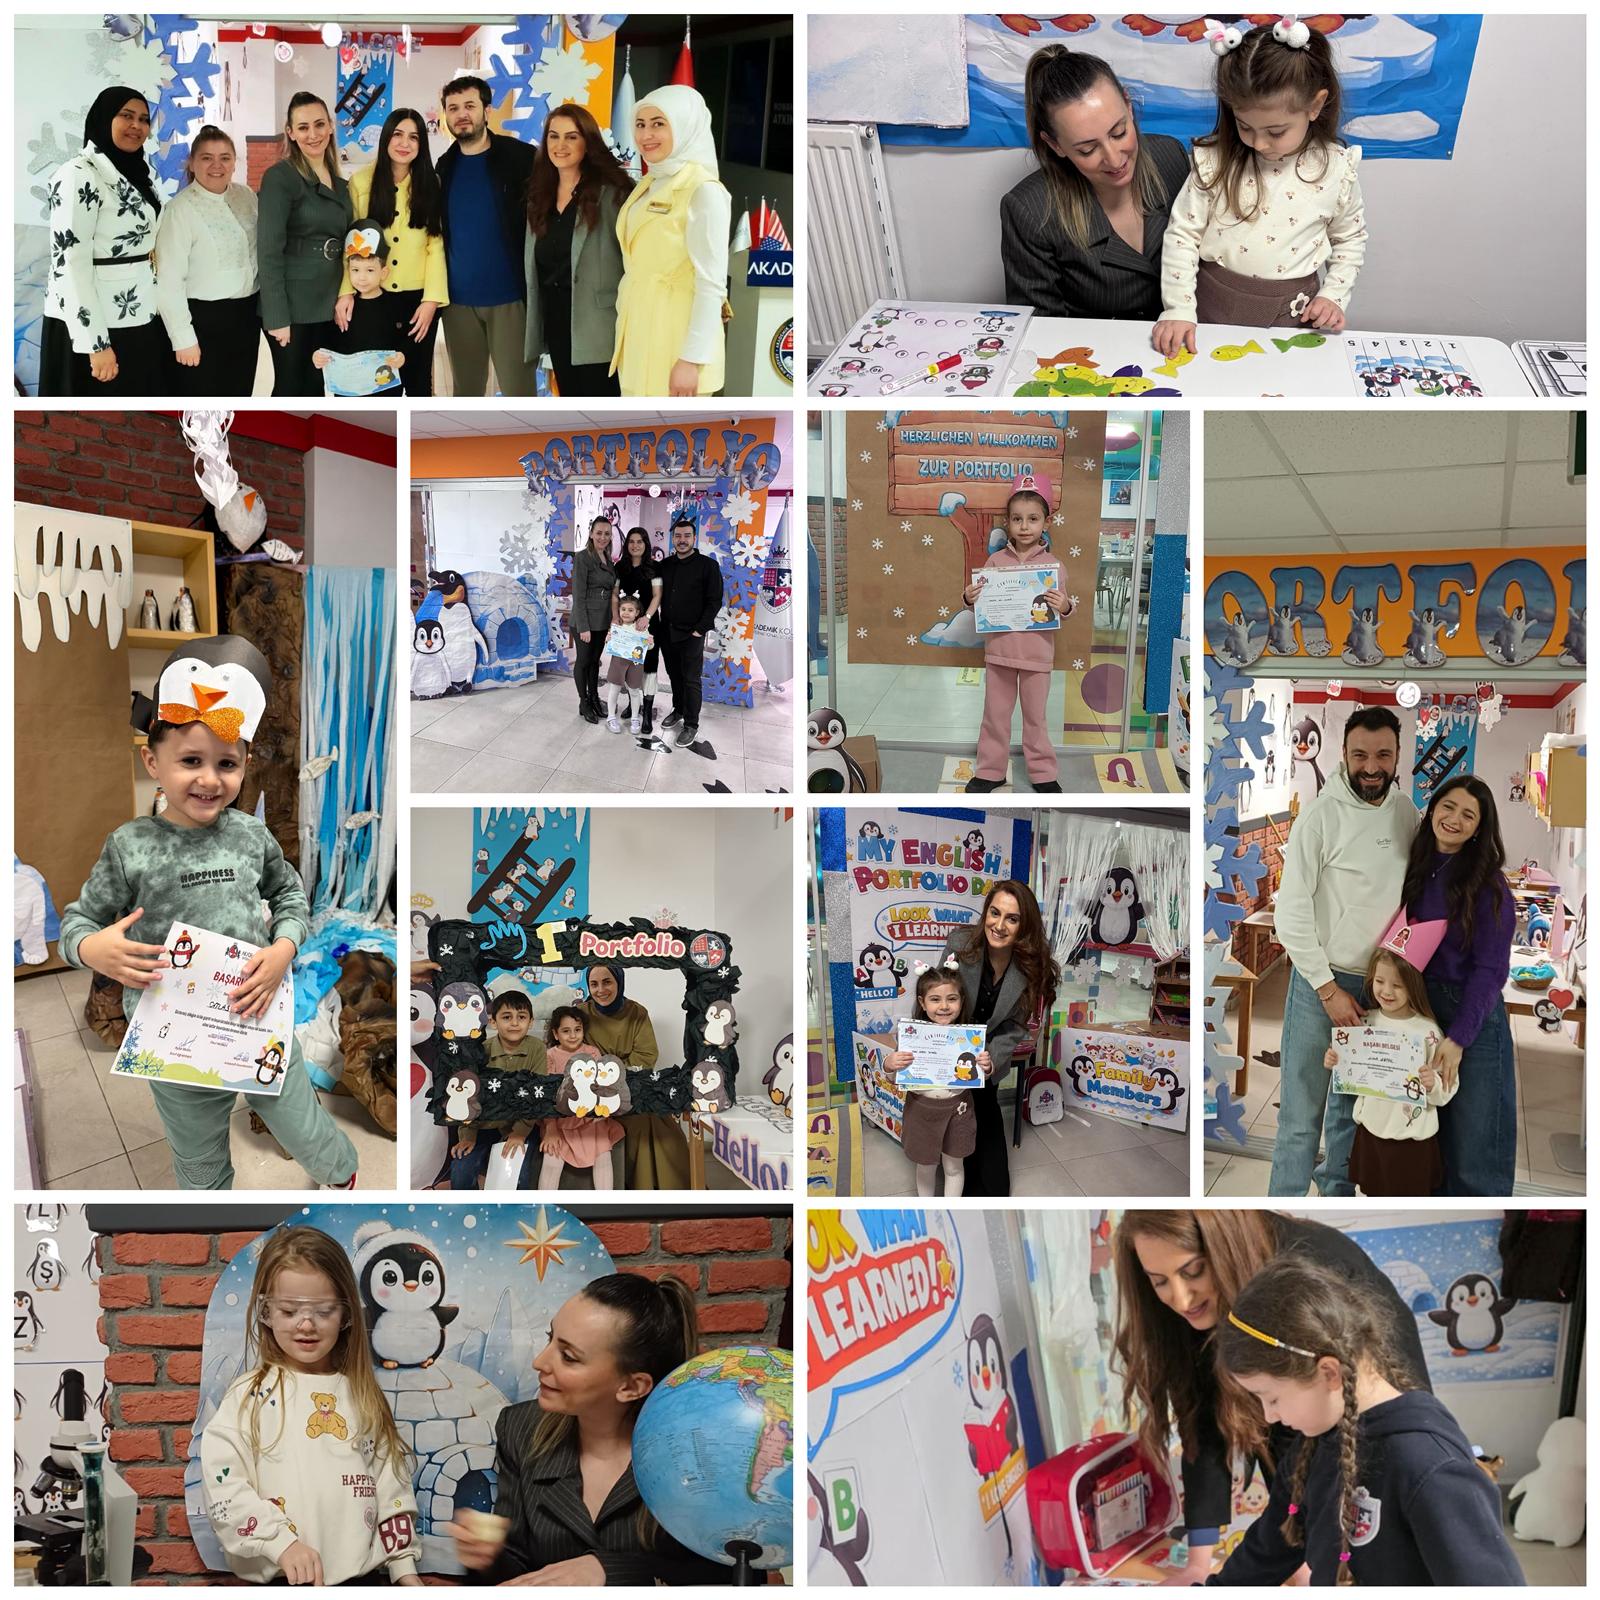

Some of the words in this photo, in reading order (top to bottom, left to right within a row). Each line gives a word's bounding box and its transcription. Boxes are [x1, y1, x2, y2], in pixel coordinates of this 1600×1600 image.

[900, 430, 974, 444] HERZLICHEN
[977, 431, 1058, 448] WILLKOMMEN
[519, 428, 781, 494] PORTFOLYO
[918, 458, 951, 477] ZUR
[953, 460, 1034, 480] PORTFOLIO
[857, 835, 896, 862] MY
[901, 838, 1002, 876] ENGLISH
[180, 868, 235, 883] HAPPINESS
[852, 865, 969, 894] PORTFOLIO
[971, 876, 996, 897] DA
[411, 896, 432, 905] ello
[889, 906, 932, 922] LOOK
[933, 907, 973, 923] WHAT
[893, 925, 901, 937] I
[905, 924, 957, 937] LEARN
[580, 931, 686, 958] Portfolio
[856, 967, 868, 982] A
[895, 959, 906, 970] B
[860, 988, 894, 999] HELLO!
[1094, 1061, 1157, 1091] Family
[1087, 1079, 1162, 1107] Members
[713, 1119, 788, 1190] Hello!
[807, 1209, 858, 1273] OK
[40, 1260, 53, 1283] Ş
[807, 1248, 940, 1362] LEARNED!
[14, 1316, 28, 1338] Z
[832, 1479, 857, 1532] B
[378, 1514, 412, 1554] 89
